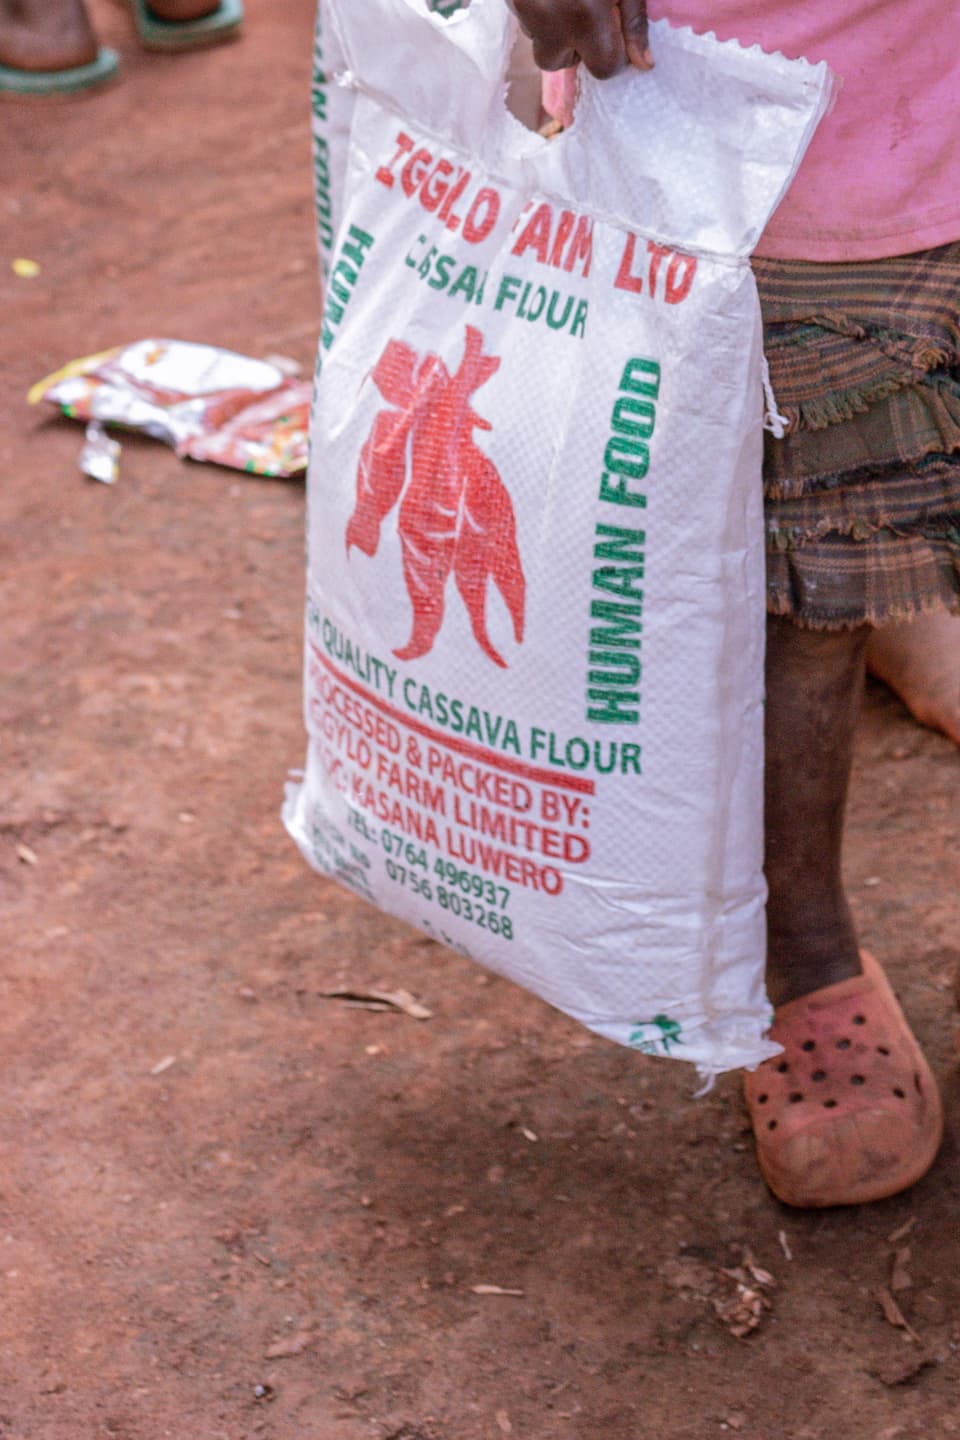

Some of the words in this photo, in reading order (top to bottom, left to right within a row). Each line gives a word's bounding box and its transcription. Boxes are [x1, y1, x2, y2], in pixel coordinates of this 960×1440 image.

[613, 231, 698, 305] LTD
[598, 356, 661, 509] FOOD
[586, 522, 647, 724] HUMAN
[322, 617, 397, 699] QUALITY
[403, 677, 521, 756] CASSAVA
[530, 726, 642, 776] FLOUR
[351, 772, 440, 849] KASANA
[446, 827, 564, 897] LUWERO
[376, 752, 446, 817] FARM
[453, 794, 592, 864] LIMITED
[406, 735, 422, 769] &
[428, 746, 533, 813] PACKED
[540, 788, 590, 830] BY:
[381, 828, 429, 871] 0764
[433, 857, 511, 910] 496937
[385, 859, 433, 902] 0756
[436, 885, 514, 941] 803268
